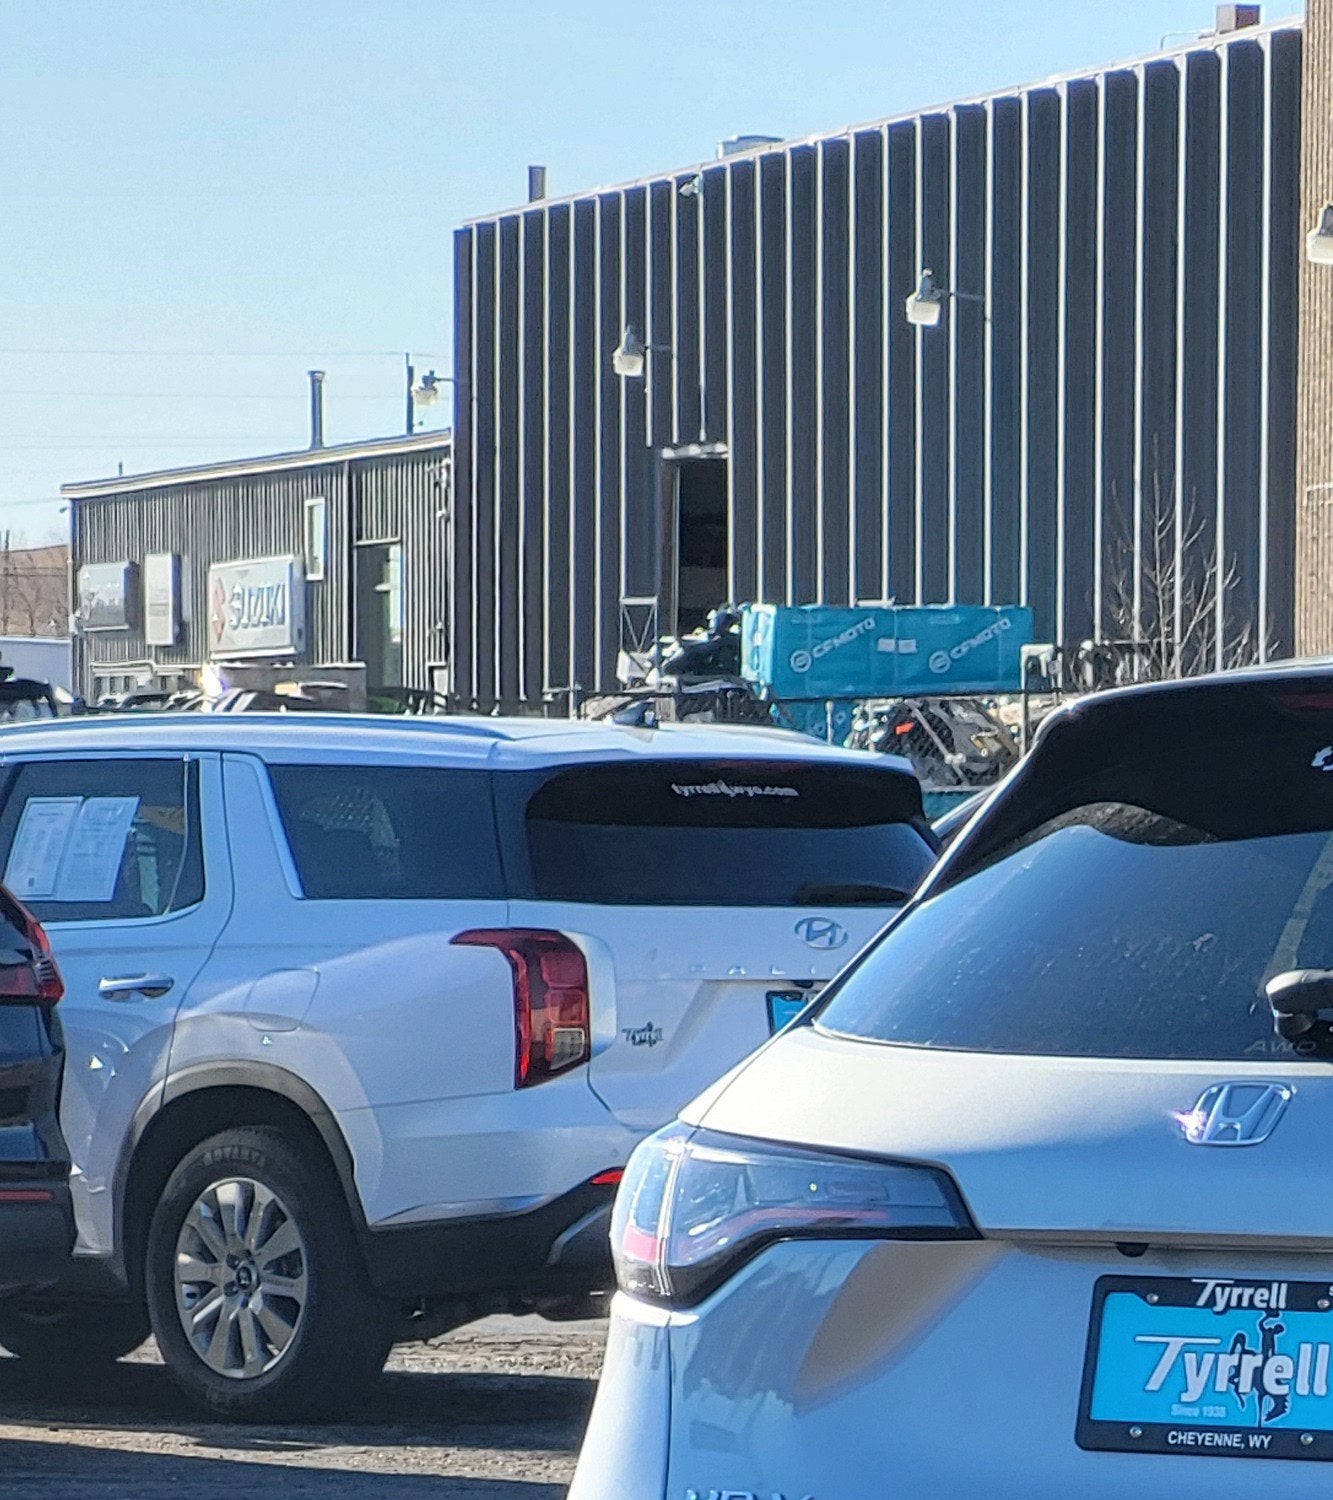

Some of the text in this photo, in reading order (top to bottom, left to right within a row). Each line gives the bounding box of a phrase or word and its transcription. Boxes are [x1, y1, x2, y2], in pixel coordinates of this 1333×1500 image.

[1191, 1278, 1288, 1311] Tyrrell
[1133, 1335, 1331, 1402] Tyrrell
[1171, 1403, 1200, 1418] Since
[1168, 1430, 1272, 1449] CHEYENNE, WY
